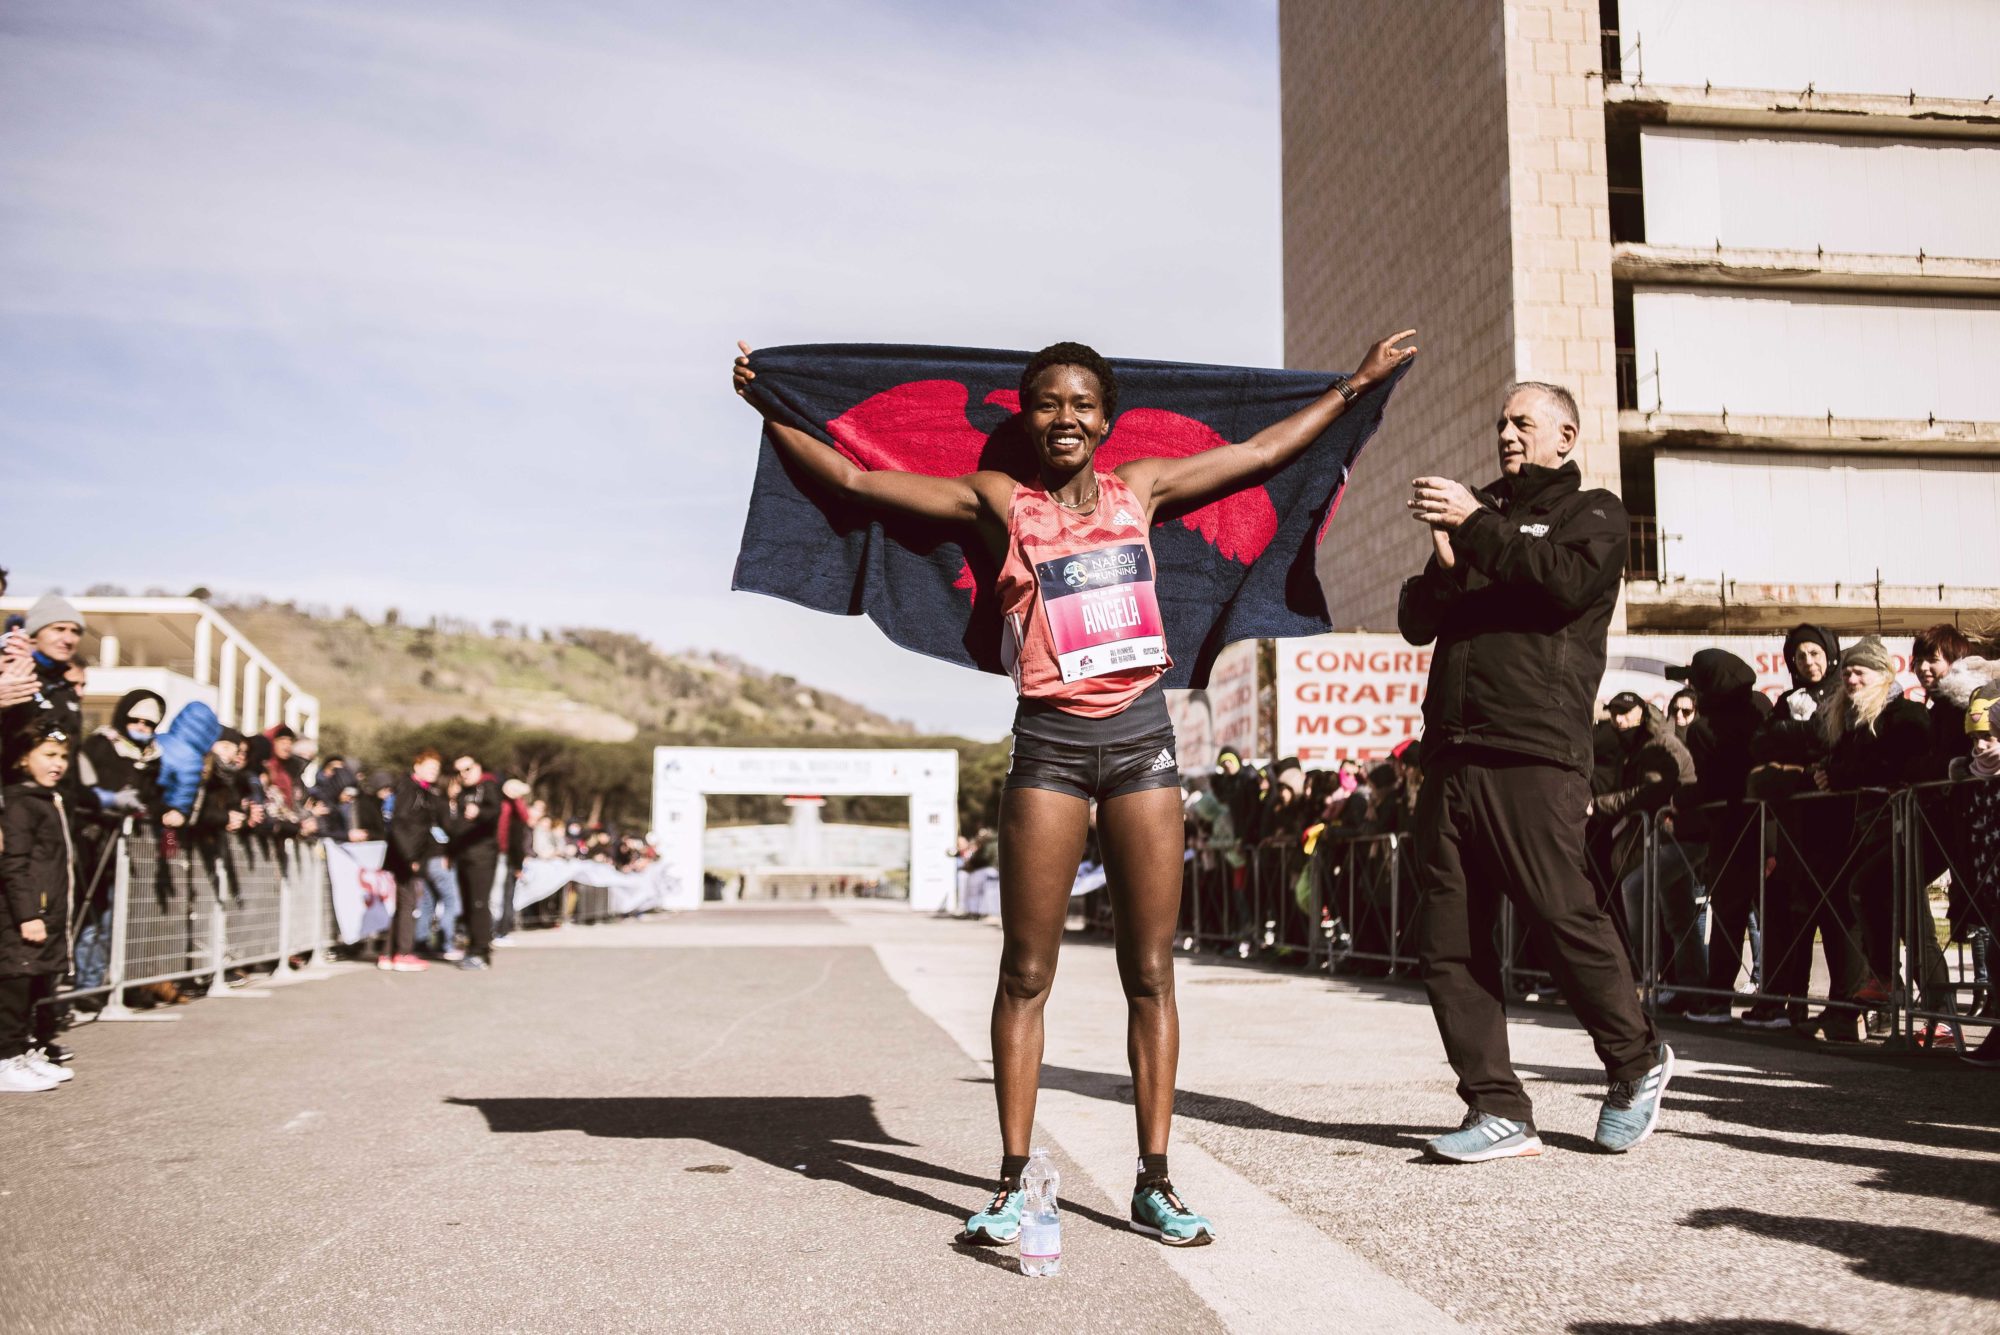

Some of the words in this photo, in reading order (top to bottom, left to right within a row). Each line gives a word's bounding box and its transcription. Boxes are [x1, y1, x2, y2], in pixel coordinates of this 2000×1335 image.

[1092, 552, 1136, 570] NAPOLI
[1093, 566, 1138, 581] RUNNING
[1081, 596, 1141, 635] ANGELA
[1296, 683, 1426, 704] GRAFI
